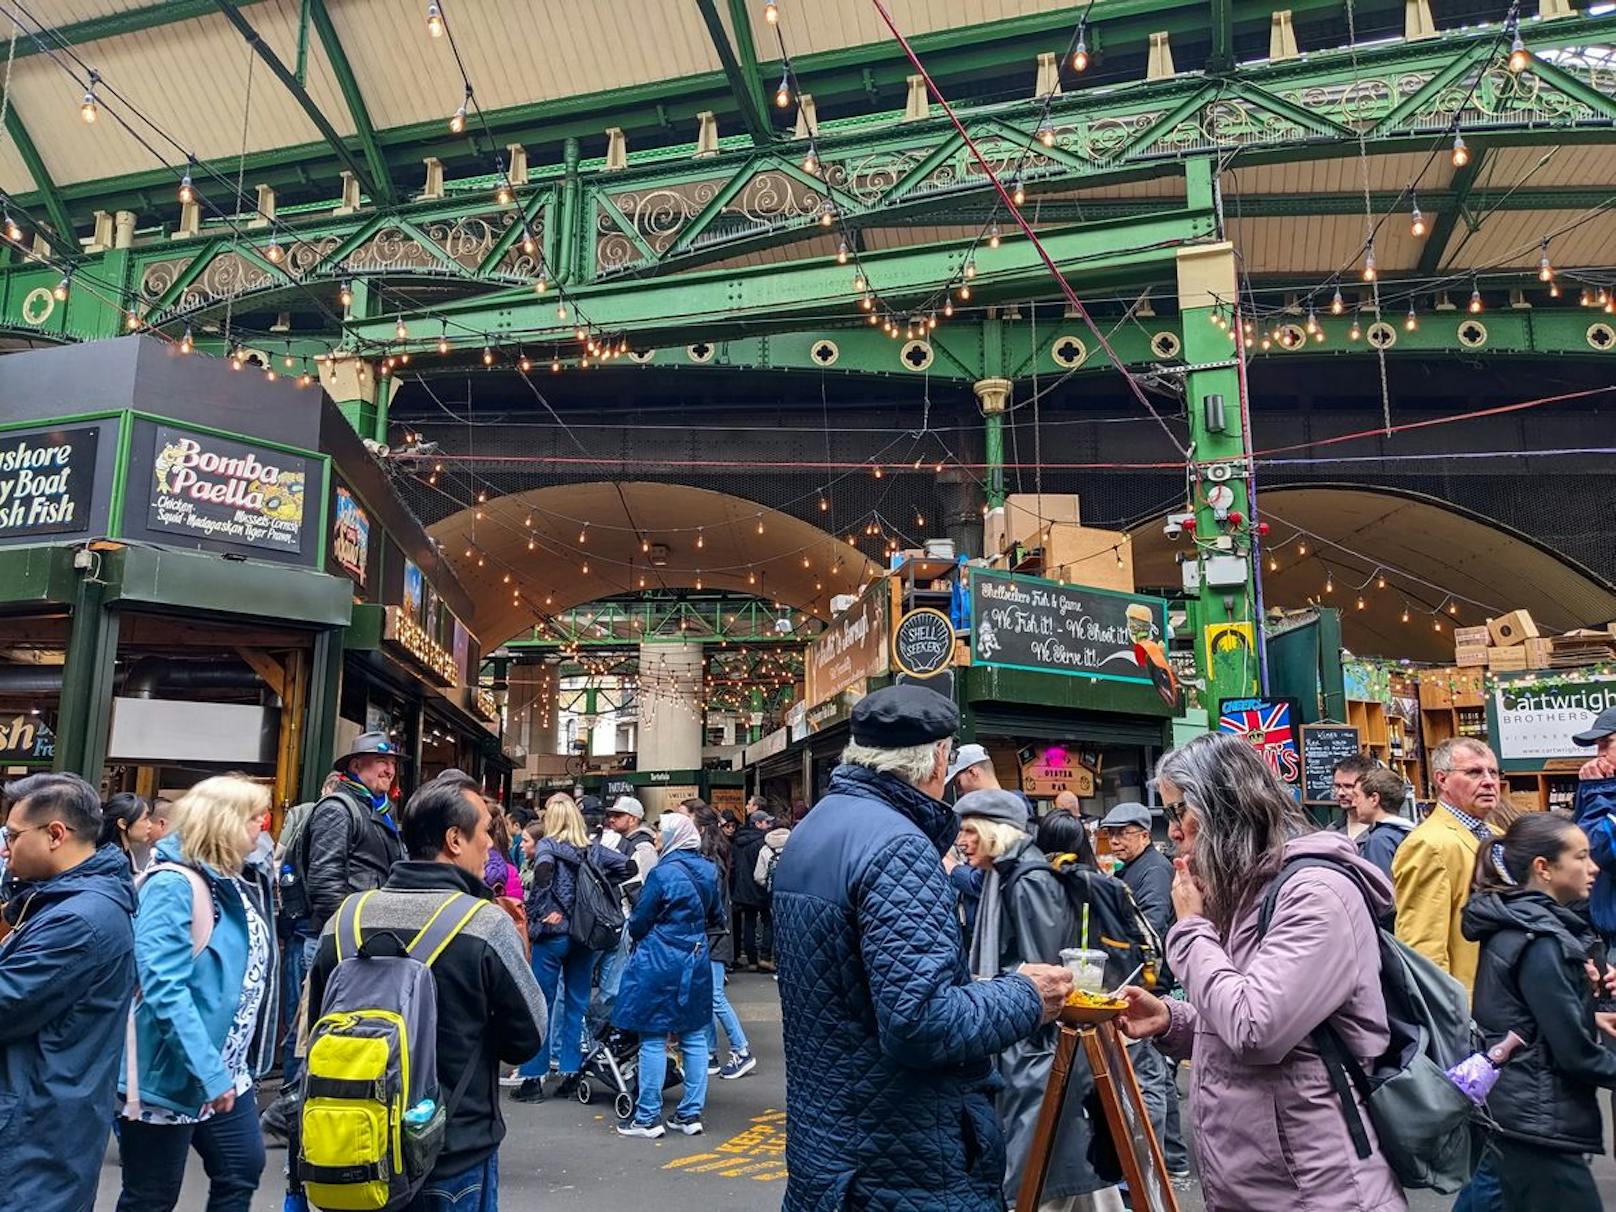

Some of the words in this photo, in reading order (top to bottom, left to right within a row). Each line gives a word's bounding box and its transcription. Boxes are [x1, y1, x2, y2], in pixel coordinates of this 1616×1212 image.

[0, 442, 72, 471] shore
[176, 438, 279, 484] Bomba
[13, 466, 71, 498] Boat
[172, 466, 264, 509] Paella
[27, 494, 75, 525] Fish
[909, 626, 937, 642] SHELL
[992, 605, 1019, 630] We
[1015, 611, 1040, 633] Fish
[1040, 617, 1053, 635] it!
[1066, 616, 1091, 640] We
[906, 641, 942, 657] SEEKERS
[1031, 638, 1059, 662] We
[1503, 712, 1589, 724] BROTHERS
